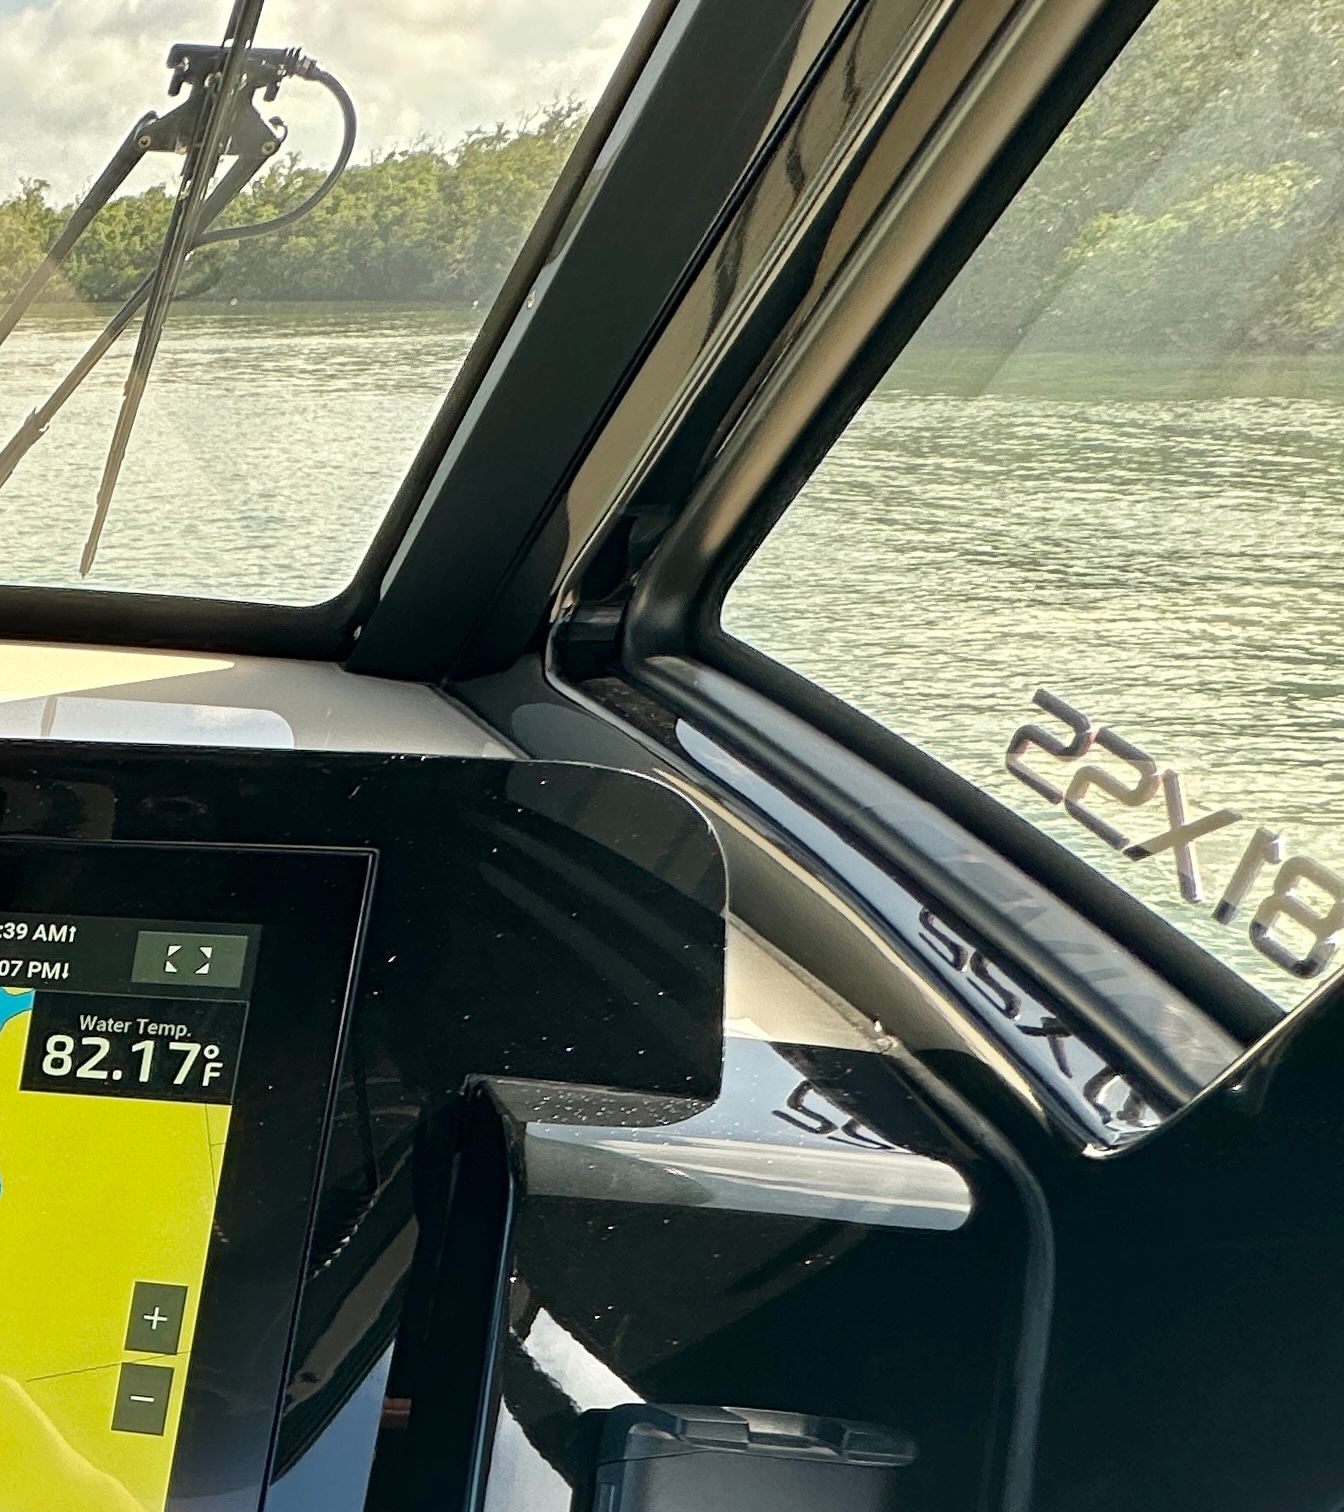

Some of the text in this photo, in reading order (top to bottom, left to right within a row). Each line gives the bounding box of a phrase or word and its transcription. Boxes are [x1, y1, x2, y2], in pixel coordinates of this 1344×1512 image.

[32, 923, 68, 943] AM
[27, 961, 63, 980] PM
[79, 1014, 192, 1040] Water Temp.
[42, 1034, 202, 1086] 82.17
